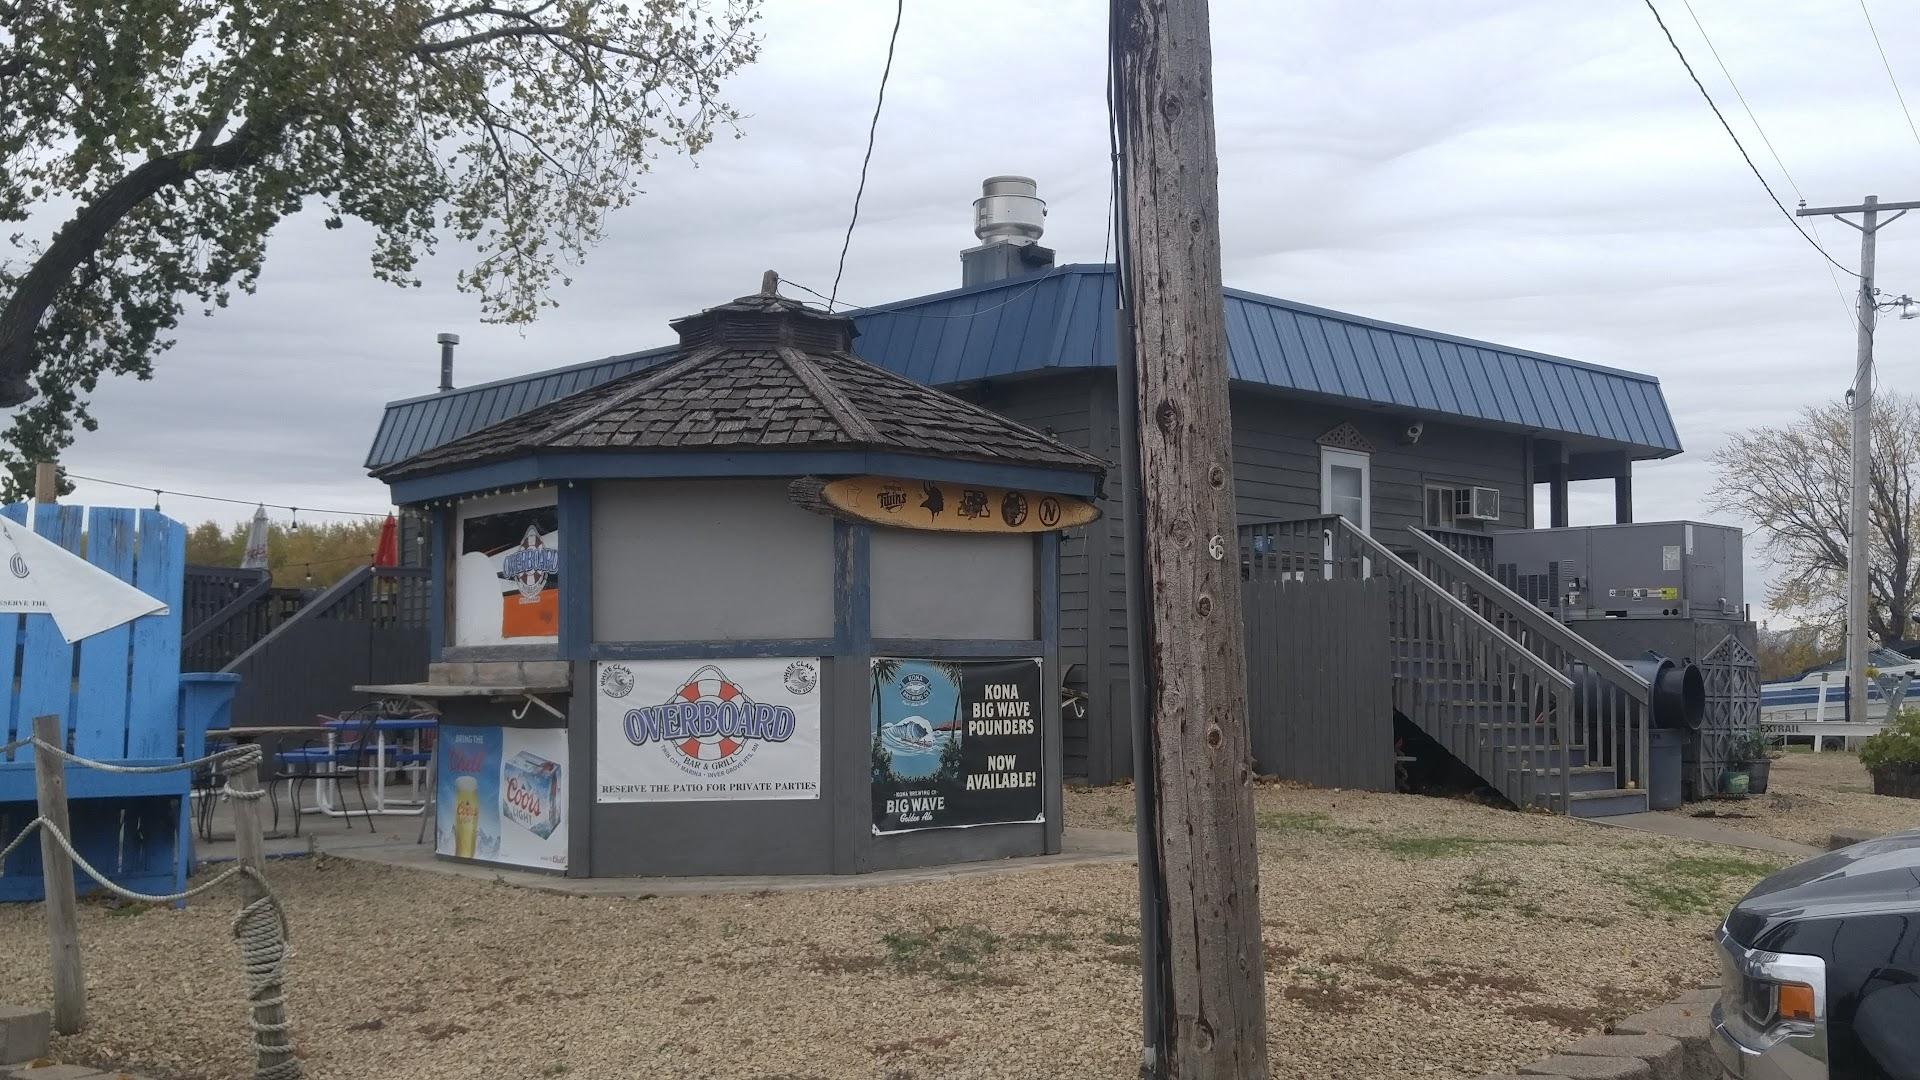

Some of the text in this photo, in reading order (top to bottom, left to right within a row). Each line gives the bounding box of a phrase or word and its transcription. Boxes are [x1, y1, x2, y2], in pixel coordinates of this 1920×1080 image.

[876, 491, 907, 509] Twins
[1209, 535, 1224, 560] 6
[503, 548, 559, 579] OVERBOARD
[600, 663, 632, 686] WHITE CLAW
[783, 660, 815, 684] WHITE CLAW
[984, 683, 1019, 700] KONA
[972, 701, 1031, 719] BIG WAVE
[623, 700, 796, 746] OVERBOARD
[968, 718, 1035, 736] POUNDERS
[660, 744, 671, 758] TWIN
[670, 757, 681, 767] CITY
[680, 765, 702, 777] MARINA
[707, 770, 725, 778] INVER
[725, 761, 744, 775] GROVE
[683, 756, 737, 770] BAR & GRILL
[987, 754, 1017, 772] NOW
[602, 781, 817, 793] RESERVE THE PATIO FOR PRIVATE PARTIES
[966, 771, 1037, 791] AVAILABLE!
[506, 776, 541, 817] Coors
[886, 796, 945, 814] BIG WAVE
[512, 806, 534, 826] LIGHT
[899, 811, 934, 823] Golden Ale
